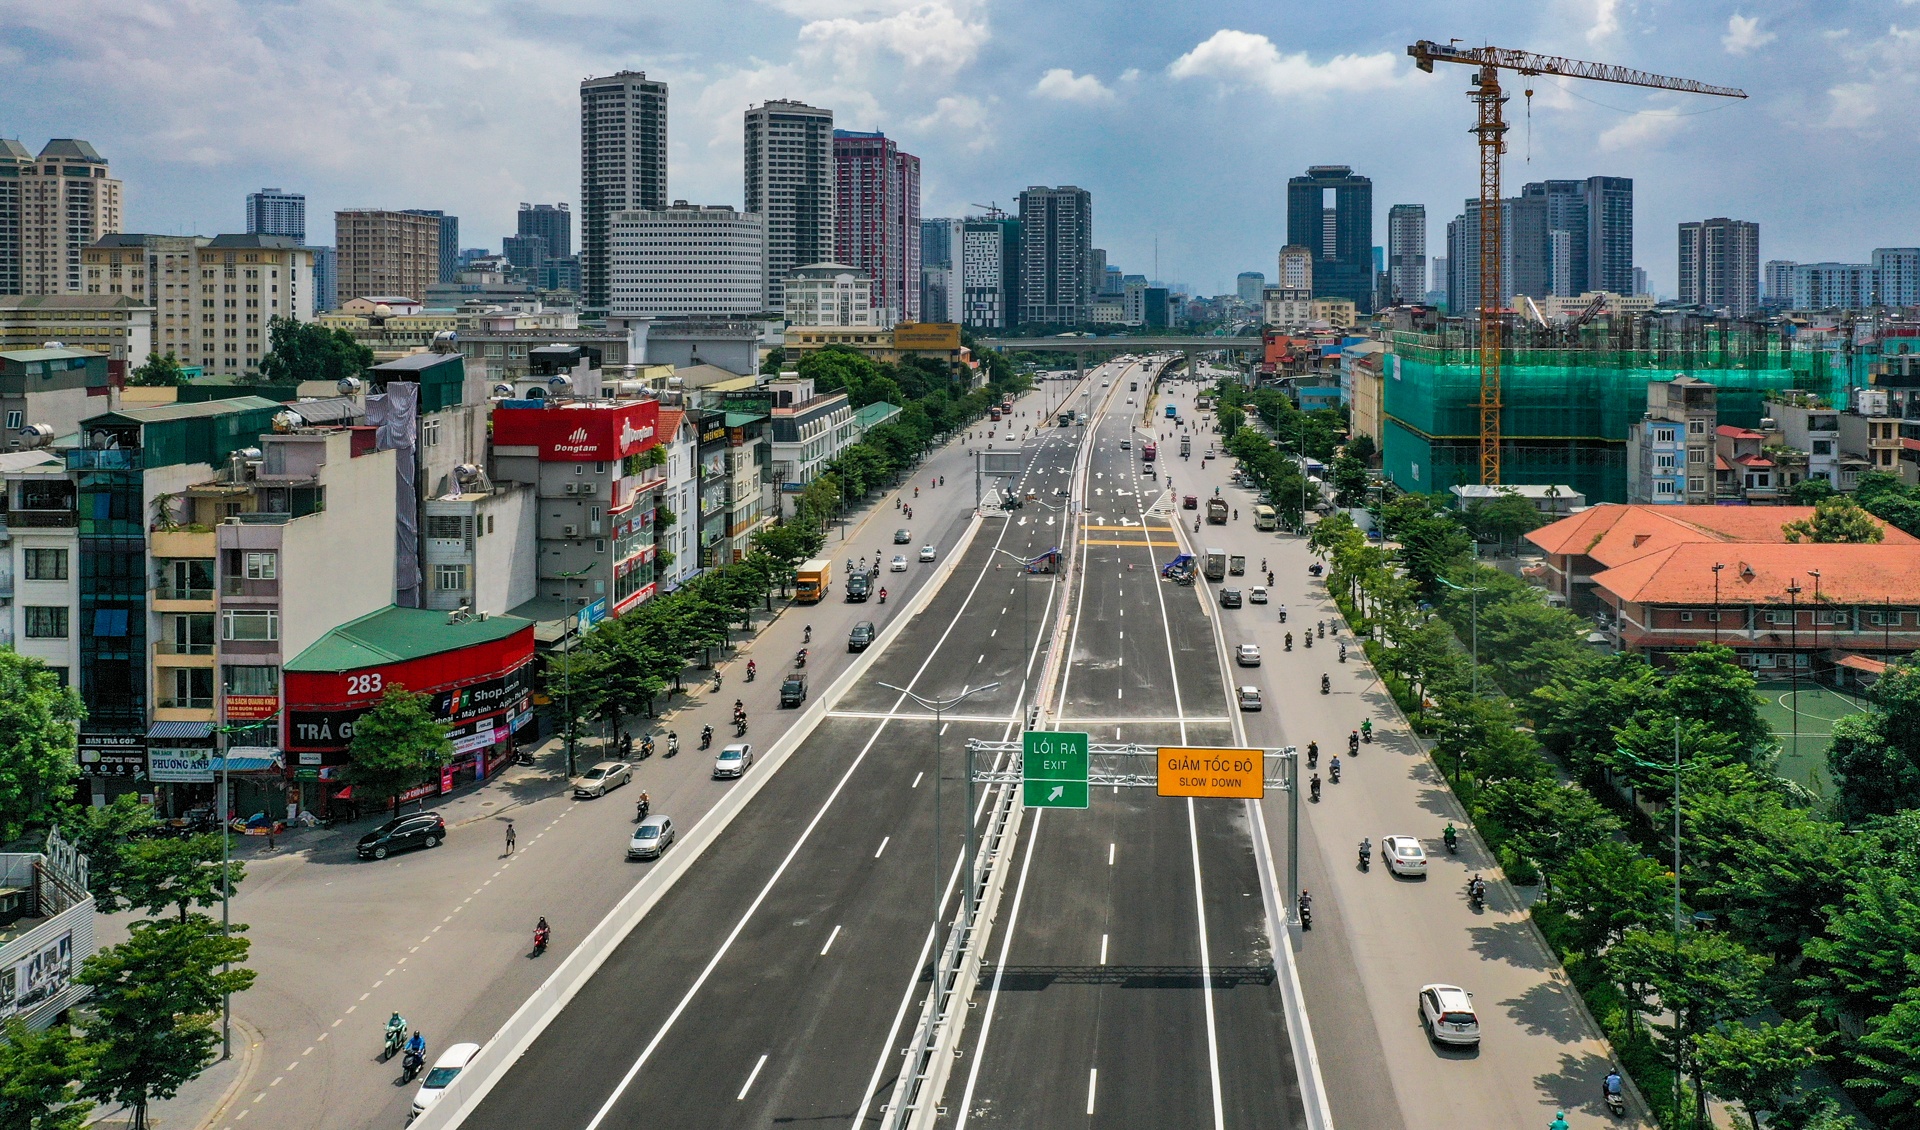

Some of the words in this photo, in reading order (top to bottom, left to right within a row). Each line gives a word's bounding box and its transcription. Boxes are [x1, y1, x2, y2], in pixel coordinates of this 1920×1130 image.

[554, 444, 598, 453] Dongtam
[347, 673, 382, 696] 283
[442, 692, 469, 712] FPT
[462, 705, 476, 720] Máy
[478, 702, 492, 714] tính
[297, 718, 333, 740] TRẢ
[103, 736, 118, 745] TRẢ
[119, 736, 136, 745] GÓP
[1033, 737, 1054, 755] LỐI
[1060, 743, 1078, 756] RA
[152, 758, 189, 769] PHƯƠNG
[190, 759, 210, 770] ANH
[1043, 760, 1067, 771] EXIT
[1168, 754, 1200, 772] GIẢM
[1204, 754, 1231, 772] TỐC
[1234, 757, 1253, 774] ĐỘ
[1179, 777, 1207, 788] SLOW
[1211, 777, 1242, 788] DOWN
